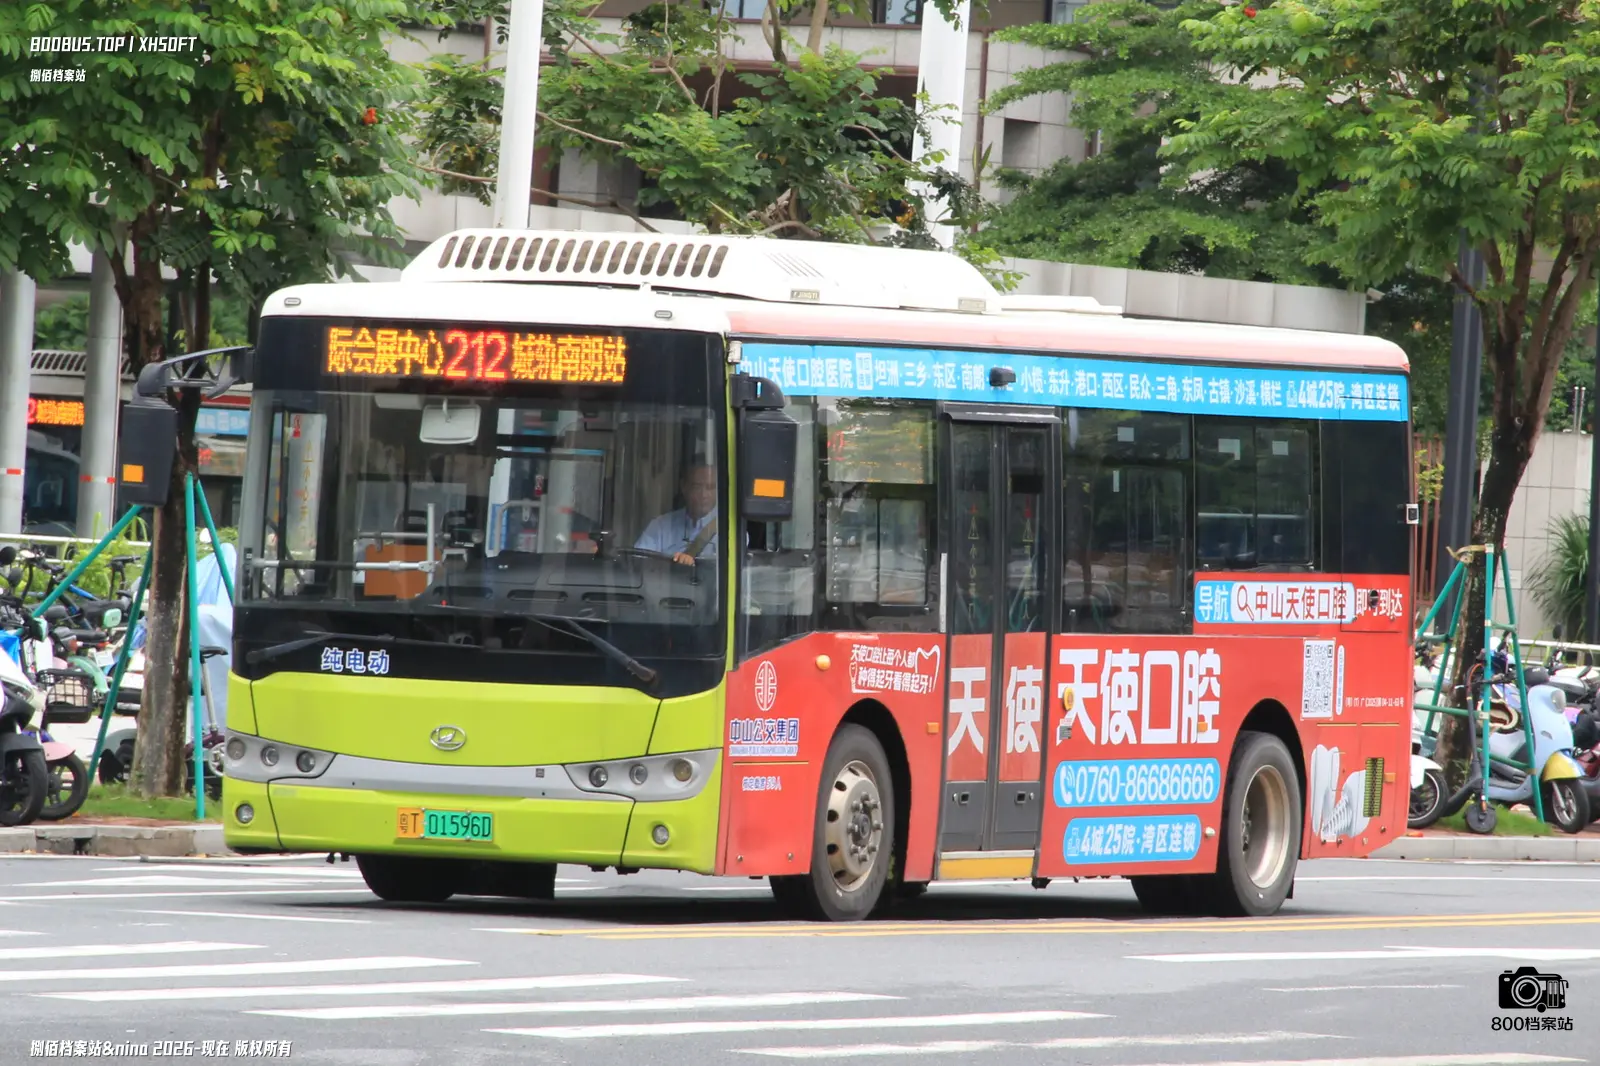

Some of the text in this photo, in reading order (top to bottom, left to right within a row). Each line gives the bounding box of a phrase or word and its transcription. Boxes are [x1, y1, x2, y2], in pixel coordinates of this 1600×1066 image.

[327, 327, 626, 382] 际会展中心 212 城轨南朗站
[1199, 585, 1229, 621] 导航
[1255, 584, 1347, 621] 中山天使口腔
[321, 647, 390, 674] 纯电动
[1056, 648, 1221, 746] 天使口腔
[729, 717, 800, 744] 中山公交集团
[1075, 762, 1215, 804] 0760-86686666
[1080, 822, 1197, 857] 4城25院·湾区连锁
